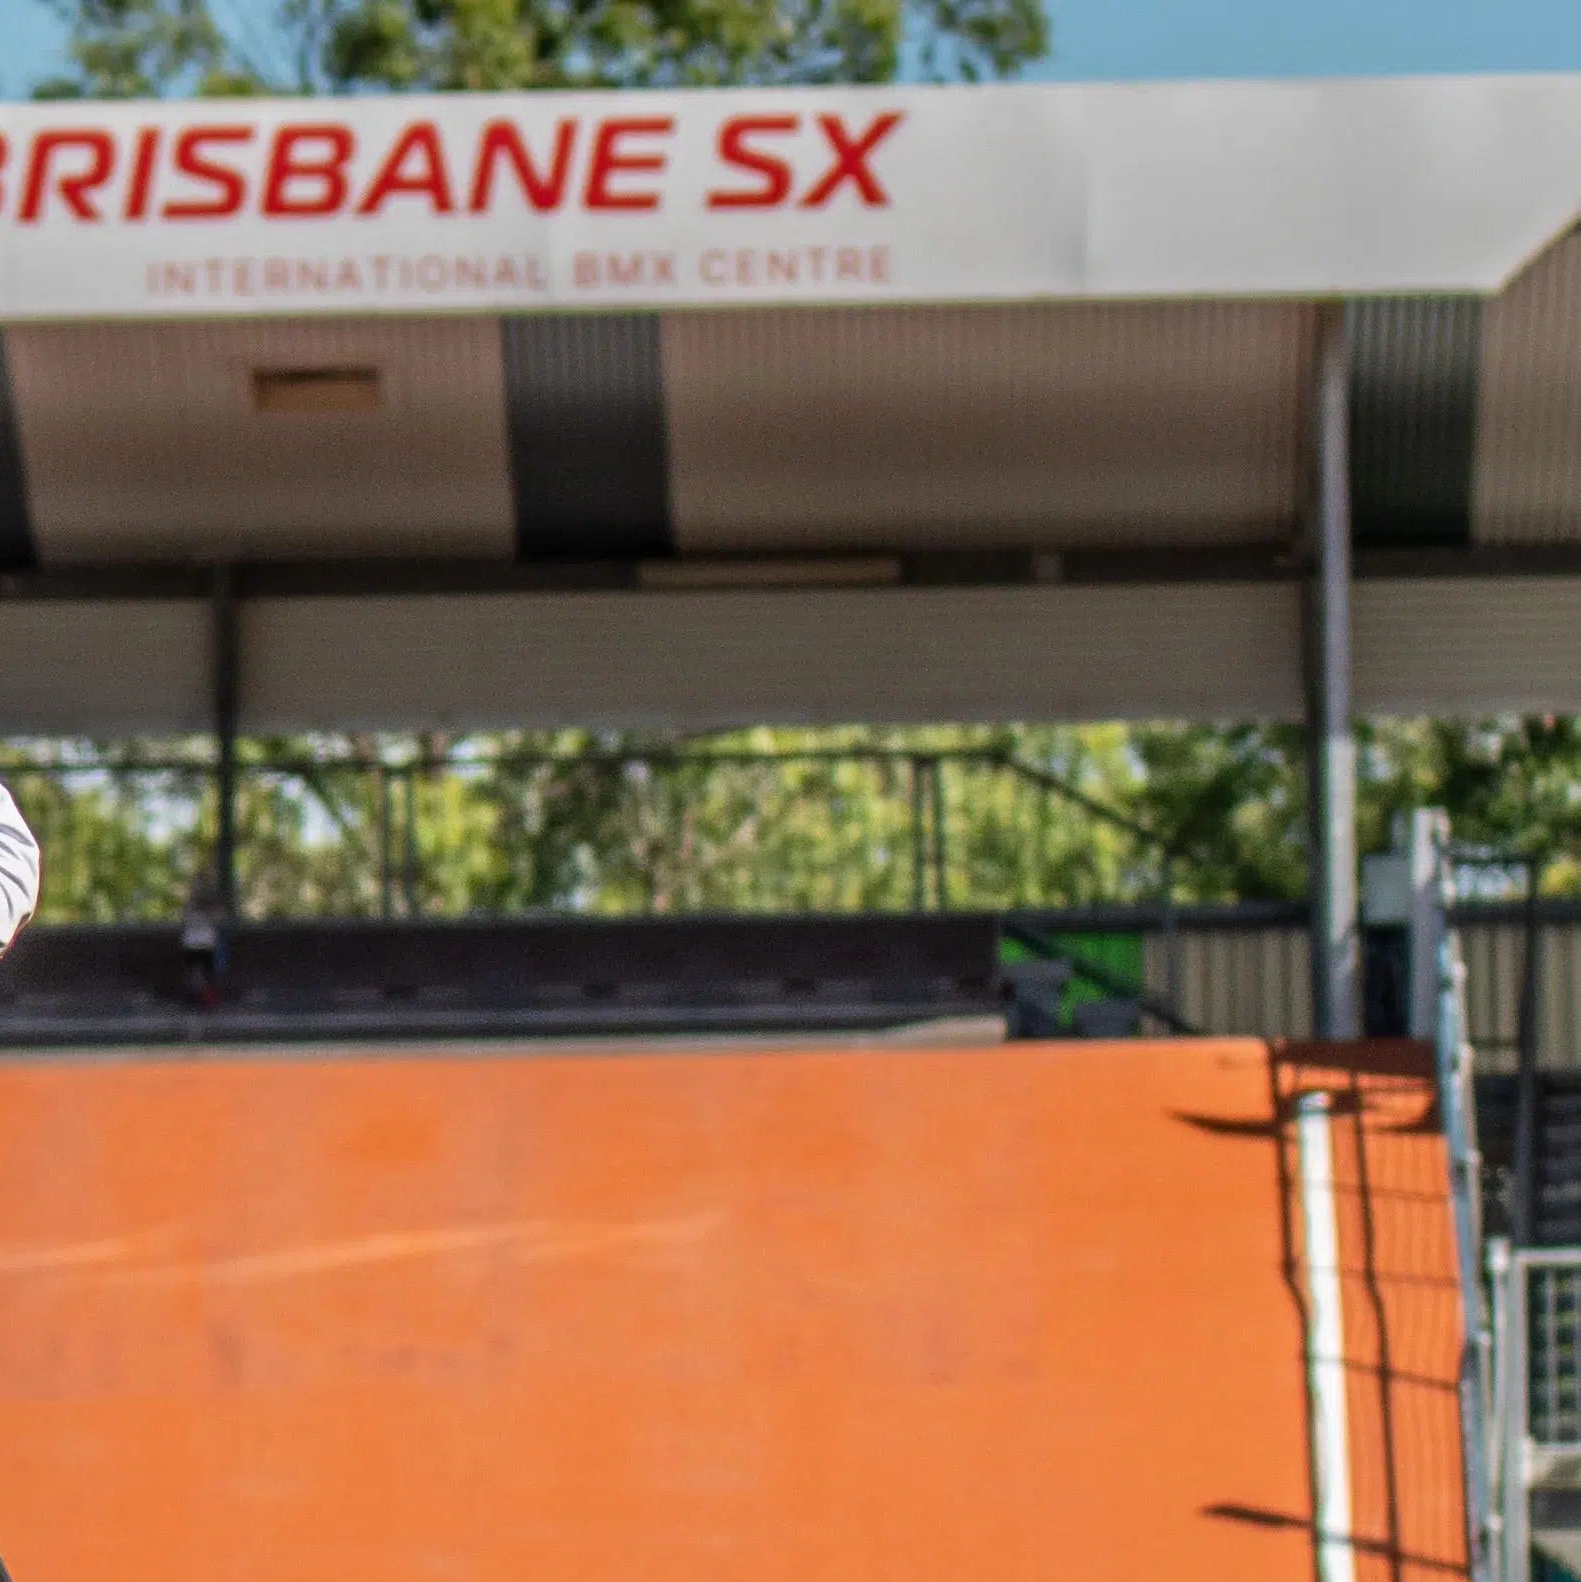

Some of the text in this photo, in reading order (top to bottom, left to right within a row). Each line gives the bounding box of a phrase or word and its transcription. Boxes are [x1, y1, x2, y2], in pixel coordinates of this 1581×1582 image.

[705, 112, 908, 212] SX
[146, 245, 893, 298] INTERNATIONAL BMX CENTRE
